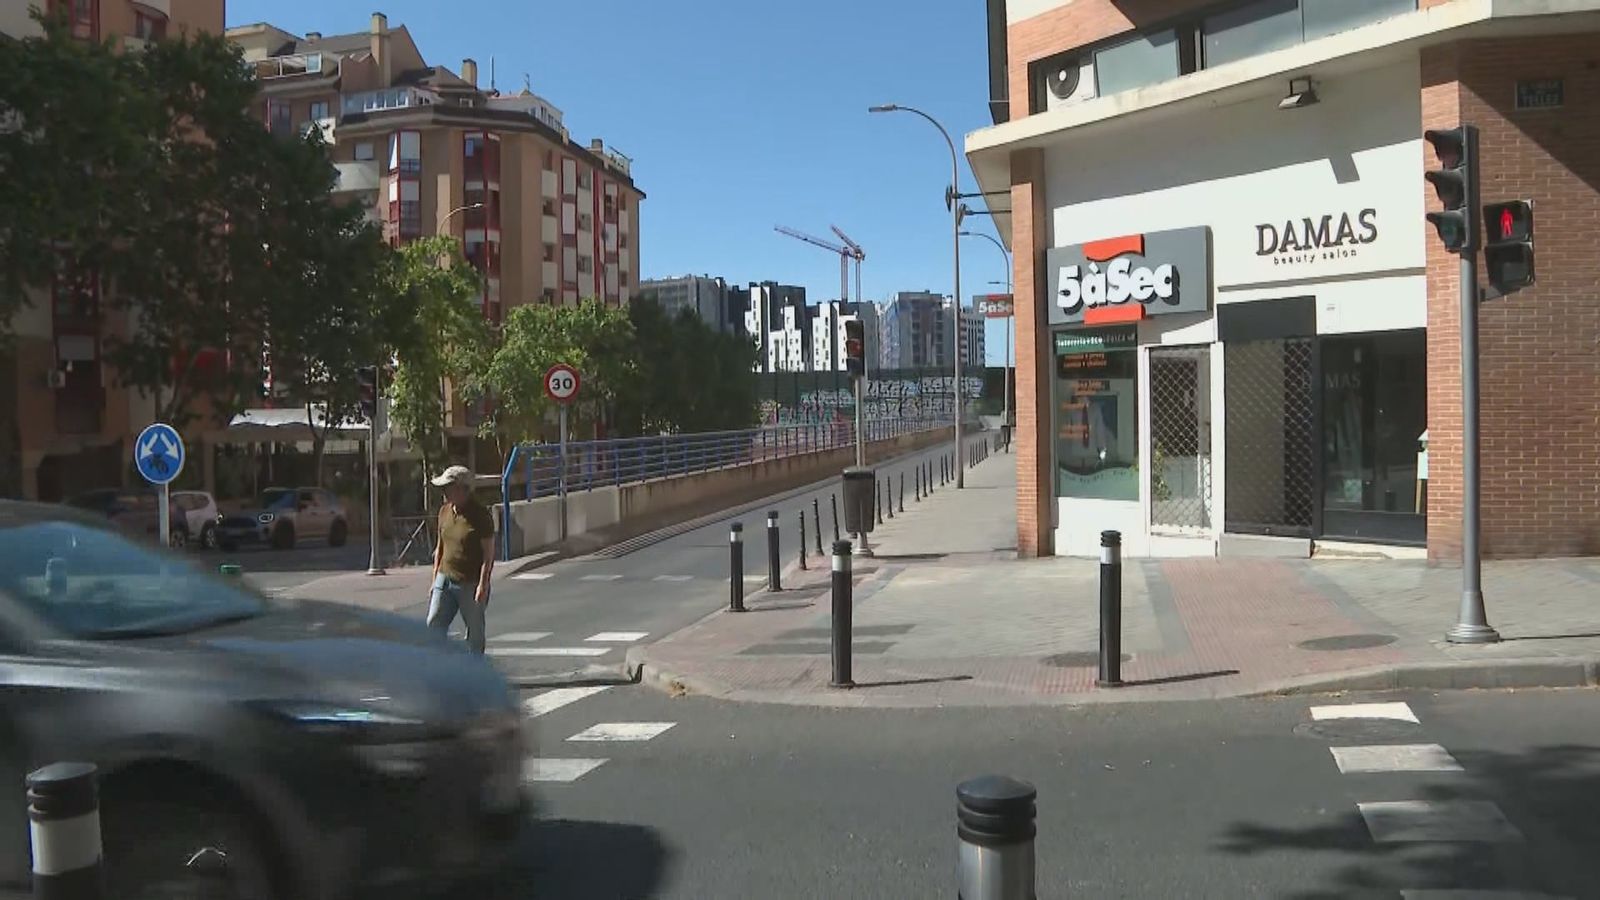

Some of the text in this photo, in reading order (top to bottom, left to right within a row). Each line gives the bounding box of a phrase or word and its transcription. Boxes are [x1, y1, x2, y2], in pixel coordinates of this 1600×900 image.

[1255, 208, 1378, 256] DAMAS
[1273, 248, 1357, 265] beauty salon
[1056, 257, 1176, 312] 5àSec
[551, 378, 572, 391] 30
